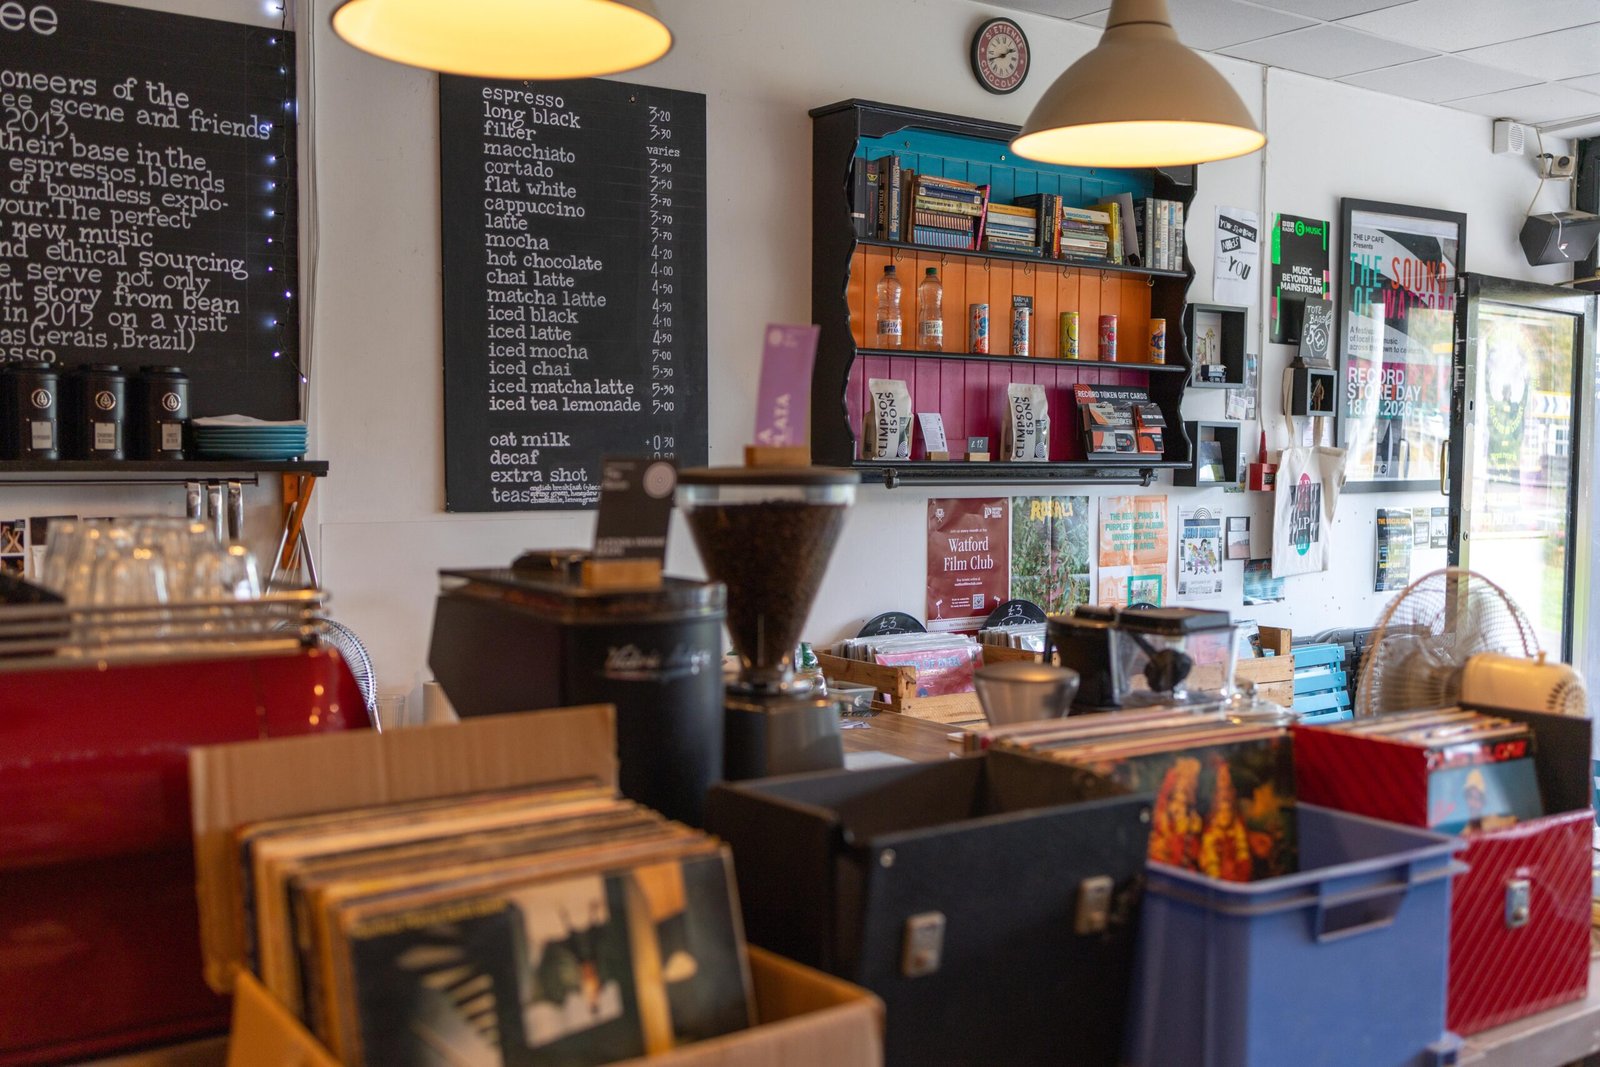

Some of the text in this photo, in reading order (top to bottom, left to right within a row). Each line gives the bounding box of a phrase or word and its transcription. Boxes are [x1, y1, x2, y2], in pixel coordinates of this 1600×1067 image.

[981, 60, 1020, 88] CHOCOLAT
[113, 77, 138, 101] of
[146, 81, 190, 109] the
[482, 87, 565, 108] espresso
[50, 98, 271, 140] scene and friends
[483, 101, 527, 129] long
[532, 107, 582, 129] black
[483, 120, 681, 157] filter varies
[70, 135, 130, 161] base
[137, 142, 161, 165] in
[168, 147, 207, 171] the
[483, 142, 576, 164] macchiato
[484, 160, 554, 178] cortado
[149, 170, 226, 193] blends
[484, 176, 521, 194] flat
[526, 180, 577, 198] white
[10, 173, 230, 218] of boundless explo-
[484, 197, 586, 218] cappuccino
[111, 208, 192, 230] perfect
[484, 213, 528, 231] latte
[12, 221, 154, 247] new music
[1305, 226, 1322, 235] MUSIC
[1353, 233, 1363, 241] THE
[1371, 235, 1385, 244] CAFE
[484, 233, 550, 250] mocha
[46, 240, 127, 266] ethical
[139, 250, 249, 281] sourcing
[486, 249, 517, 267] hot
[523, 252, 603, 271] chocolate
[1228, 255, 1251, 280] YOU
[486, 269, 527, 285] chai
[534, 271, 575, 287] latte
[1282, 273, 1322, 286] BEYOND THE
[1292, 265, 1313, 276] MUSIC
[1350, 252, 1447, 293] THE SOUND
[27, 262, 211, 299] serve not only
[1280, 282, 1323, 295] MAINSTREAM
[34, 281, 240, 314] story from bean
[487, 288, 558, 306] matcha
[562, 291, 607, 307] latte
[1353, 286, 1374, 317] OF
[3, 301, 229, 332] in 2015 on a visit
[487, 306, 527, 322] iced
[530, 309, 580, 324] black
[1307, 305, 1322, 314] TOTE
[121, 328, 197, 354] Brazil)
[487, 324, 527, 339] iced
[530, 324, 572, 341] latte
[488, 342, 527, 358] iced
[529, 344, 589, 360] mocha
[488, 360, 528, 375] iced
[532, 361, 572, 376] chai
[1348, 367, 1404, 385] RECORD
[488, 377, 528, 393] iced
[530, 378, 593, 394] matcha
[594, 378, 634, 394] latte
[1347, 383, 1421, 401] STORE DAY
[488, 396, 527, 411] iced
[531, 397, 558, 411] tea
[562, 396, 641, 412] lemonade
[1077, 390, 1100, 398] RECORD
[1100, 391, 1117, 399] TOKEN
[1129, 392, 1148, 400] CARDS
[884, 391, 898, 434] & SONS
[1020, 396, 1034, 435] & SONS
[876, 392, 889, 458] CLIMPSON
[1013, 396, 1025, 458] CLIMPSON
[489, 431, 571, 447] oat milk
[490, 449, 540, 465] decaf
[491, 468, 542, 483] extra
[550, 467, 588, 482] shot
[492, 486, 530, 503] teas
[1110, 512, 1121, 520] THE
[1298, 517, 1310, 530] LP
[948, 536, 989, 552] Watford
[943, 554, 993, 572] Film Club
[1008, 604, 1023, 616] £3
